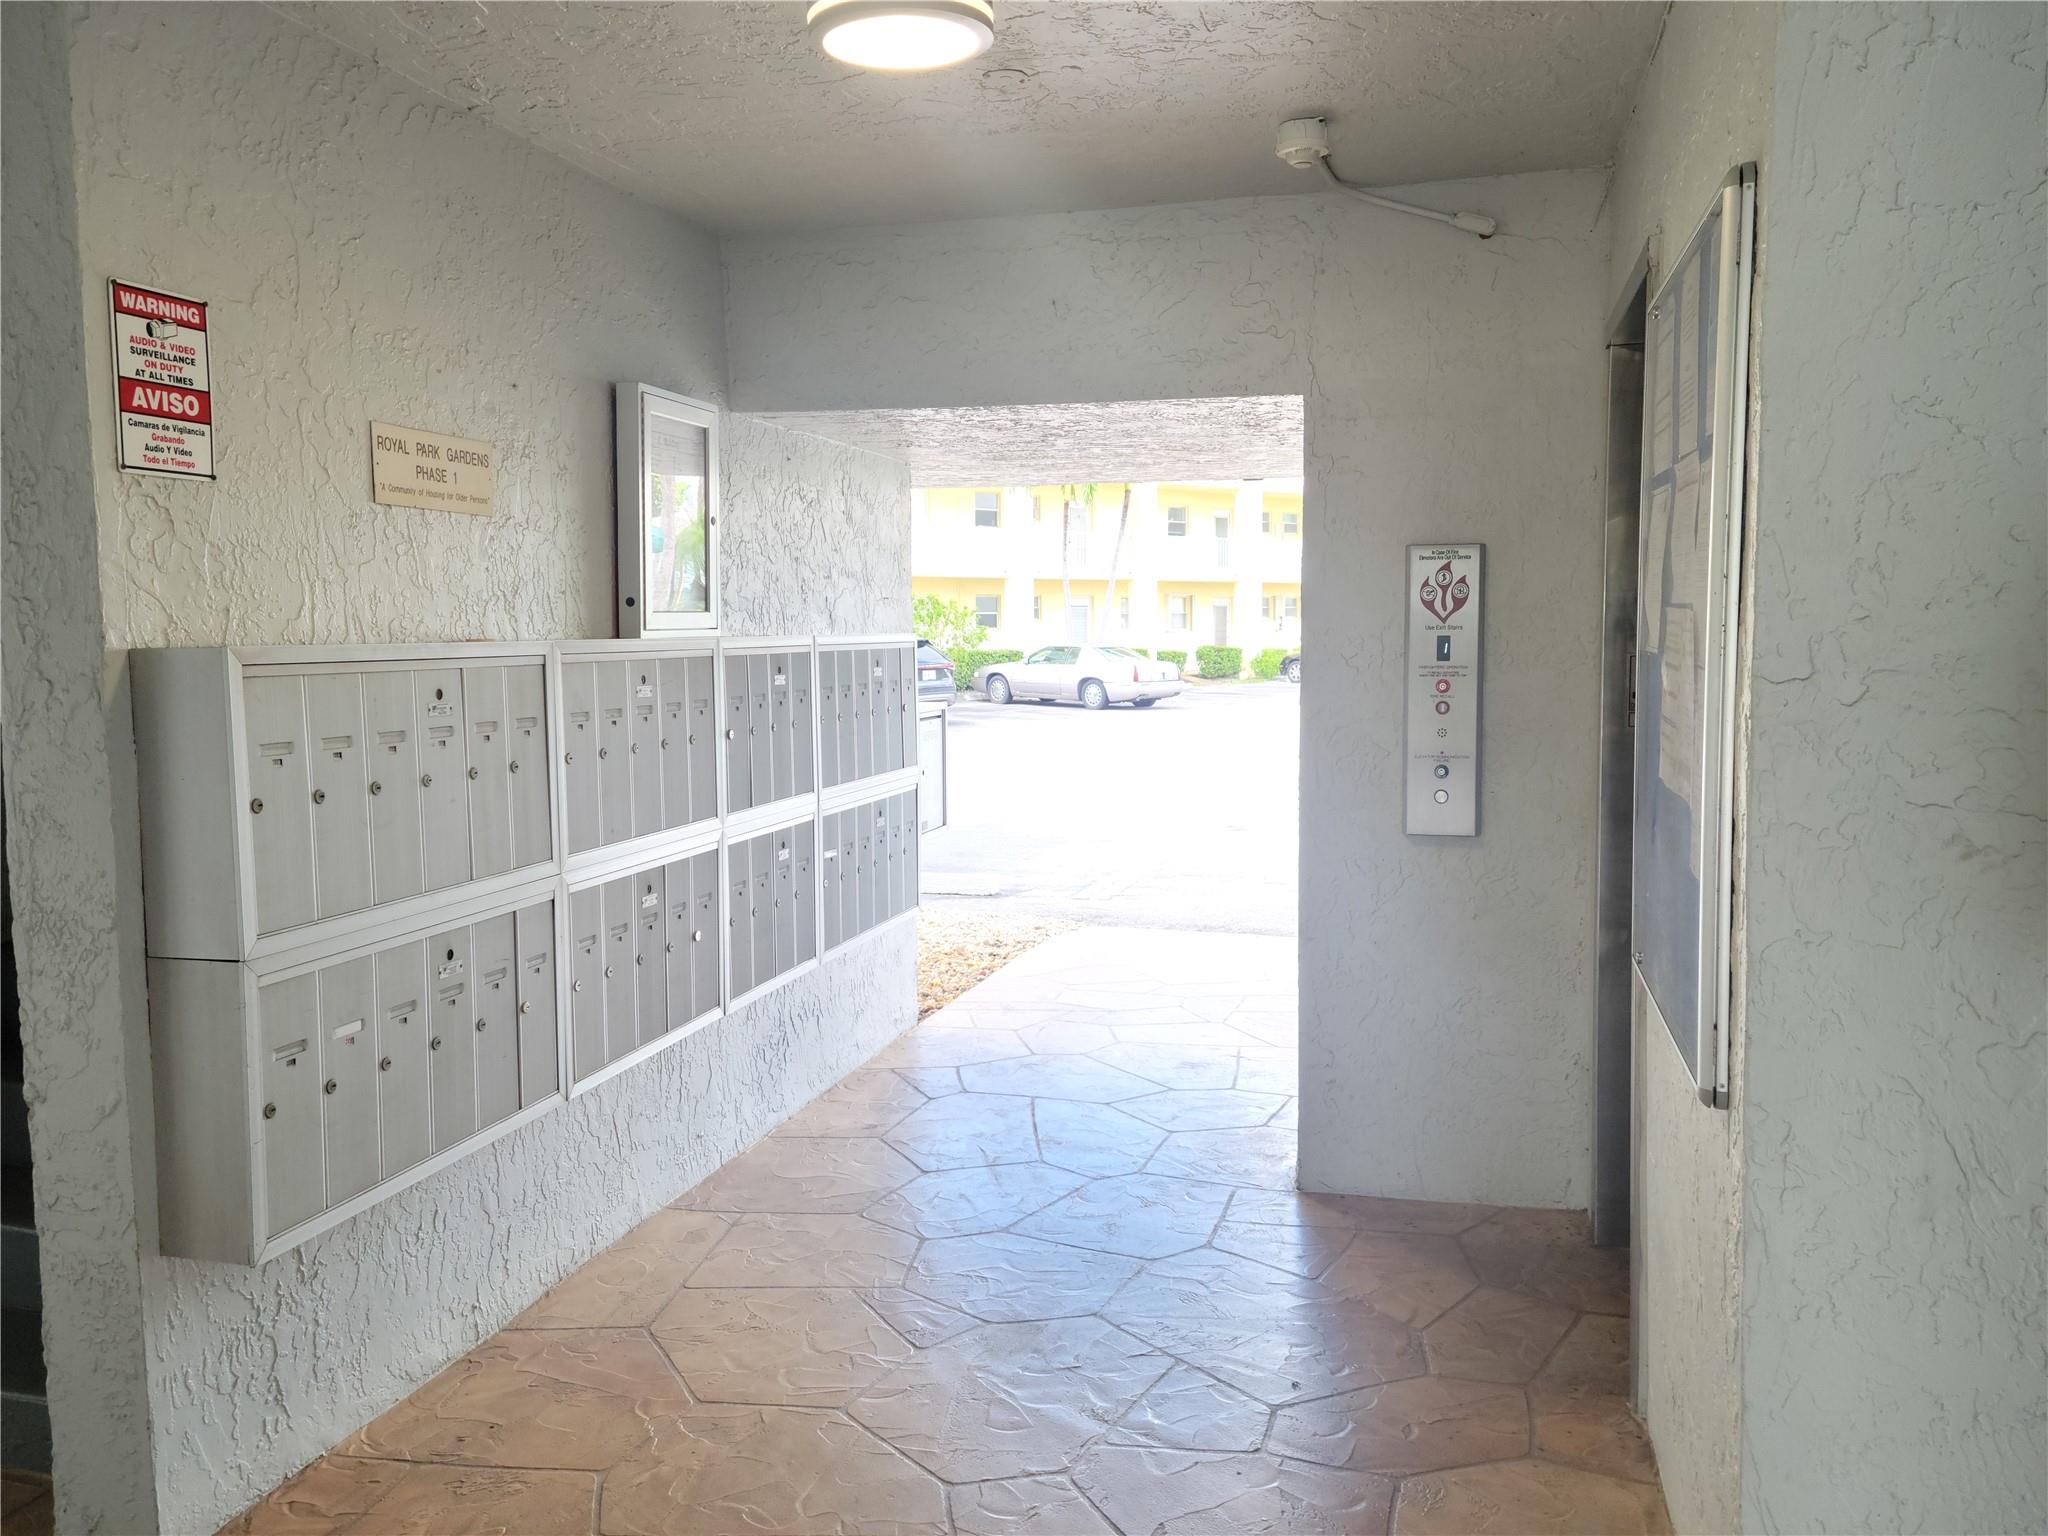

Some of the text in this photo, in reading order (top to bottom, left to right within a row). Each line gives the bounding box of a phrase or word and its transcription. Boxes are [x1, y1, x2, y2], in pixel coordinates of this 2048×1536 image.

[119, 290, 200, 324] WARNING
[129, 335, 196, 356] AUDIO & VIDEO
[130, 346, 196, 366] SURVEILLANCE
[144, 360, 184, 374] ON DUTY
[135, 368, 194, 386] AT ALL TIMES
[132, 386, 200, 417] AVISO
[128, 418, 206, 437] Camaras de Vigilancia
[152, 432, 185, 445] Grabando
[144, 443, 193, 457] Audio Y Video
[376, 435, 489, 468] ROYAL PARK GARDENS
[142, 454, 196, 469] Todo el Tiempo
[416, 465, 457, 485] PHASE 1
[388, 484, 416, 496] Community
